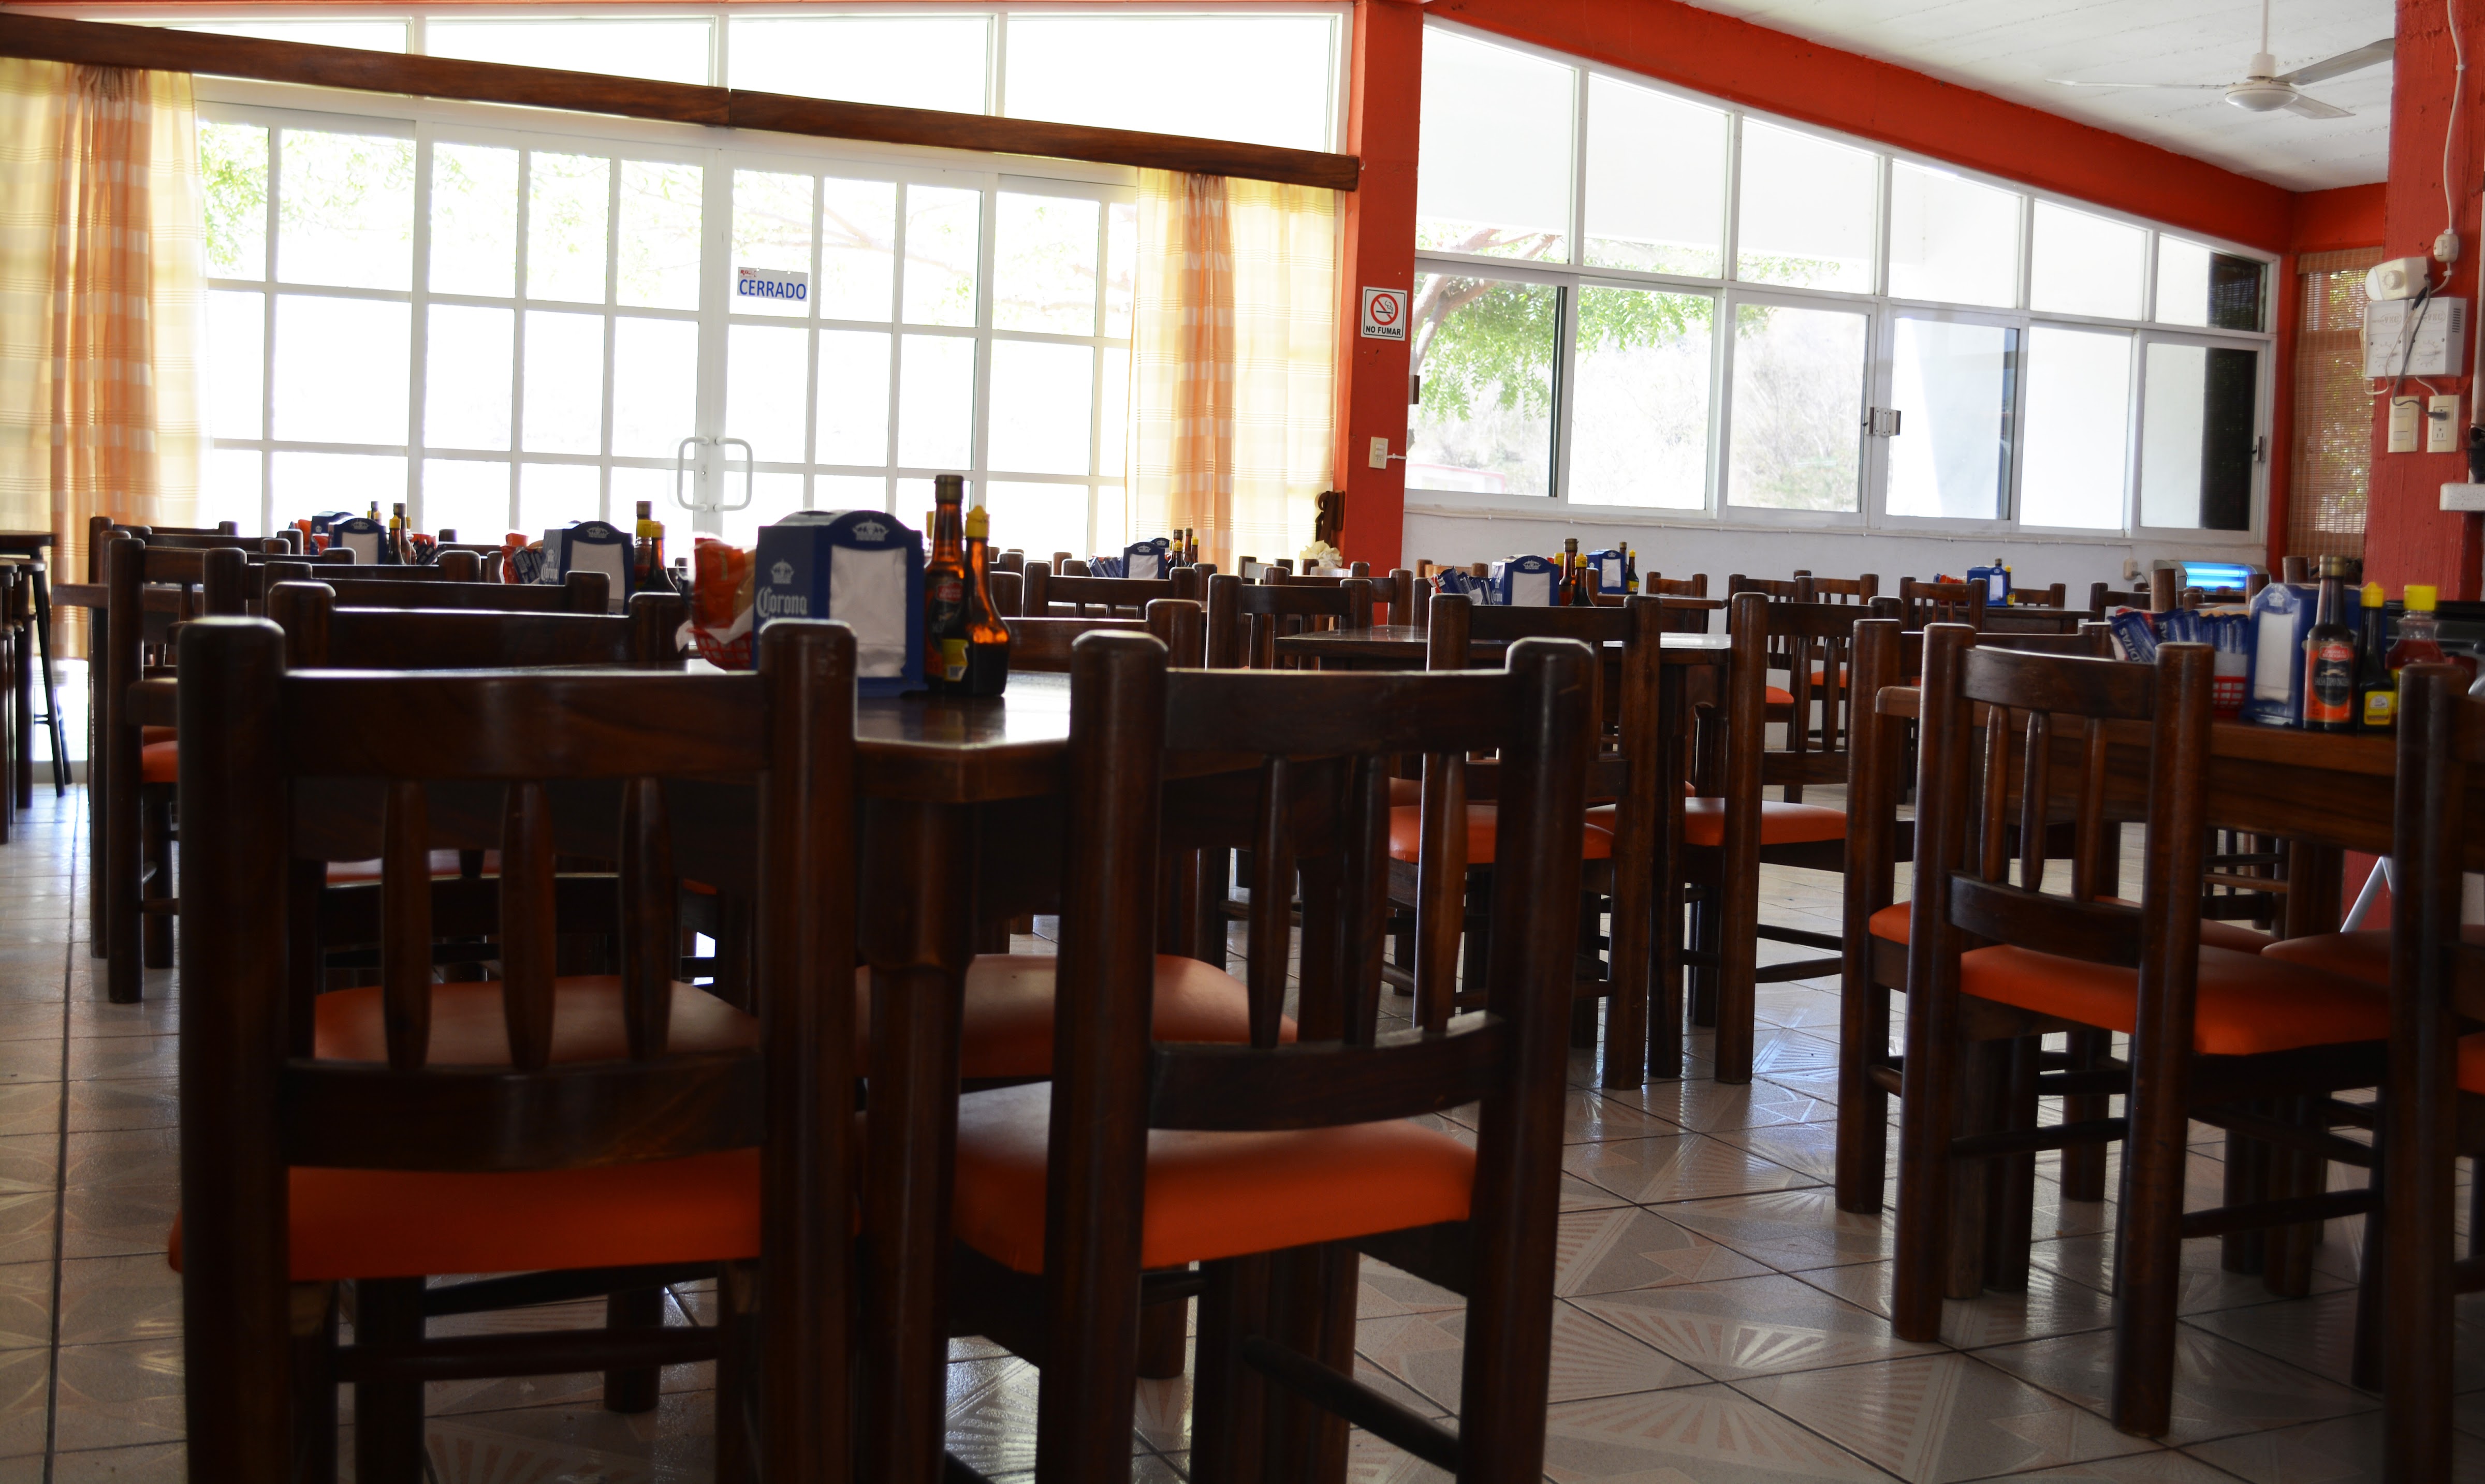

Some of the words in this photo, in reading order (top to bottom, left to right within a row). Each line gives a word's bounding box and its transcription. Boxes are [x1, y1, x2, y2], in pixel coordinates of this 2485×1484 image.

[739, 279, 806, 299] CERRADO
[1378, 327, 1401, 335] FUMAR
[757, 586, 807, 618] Corona
[2119, 627, 2142, 662] DITAS
